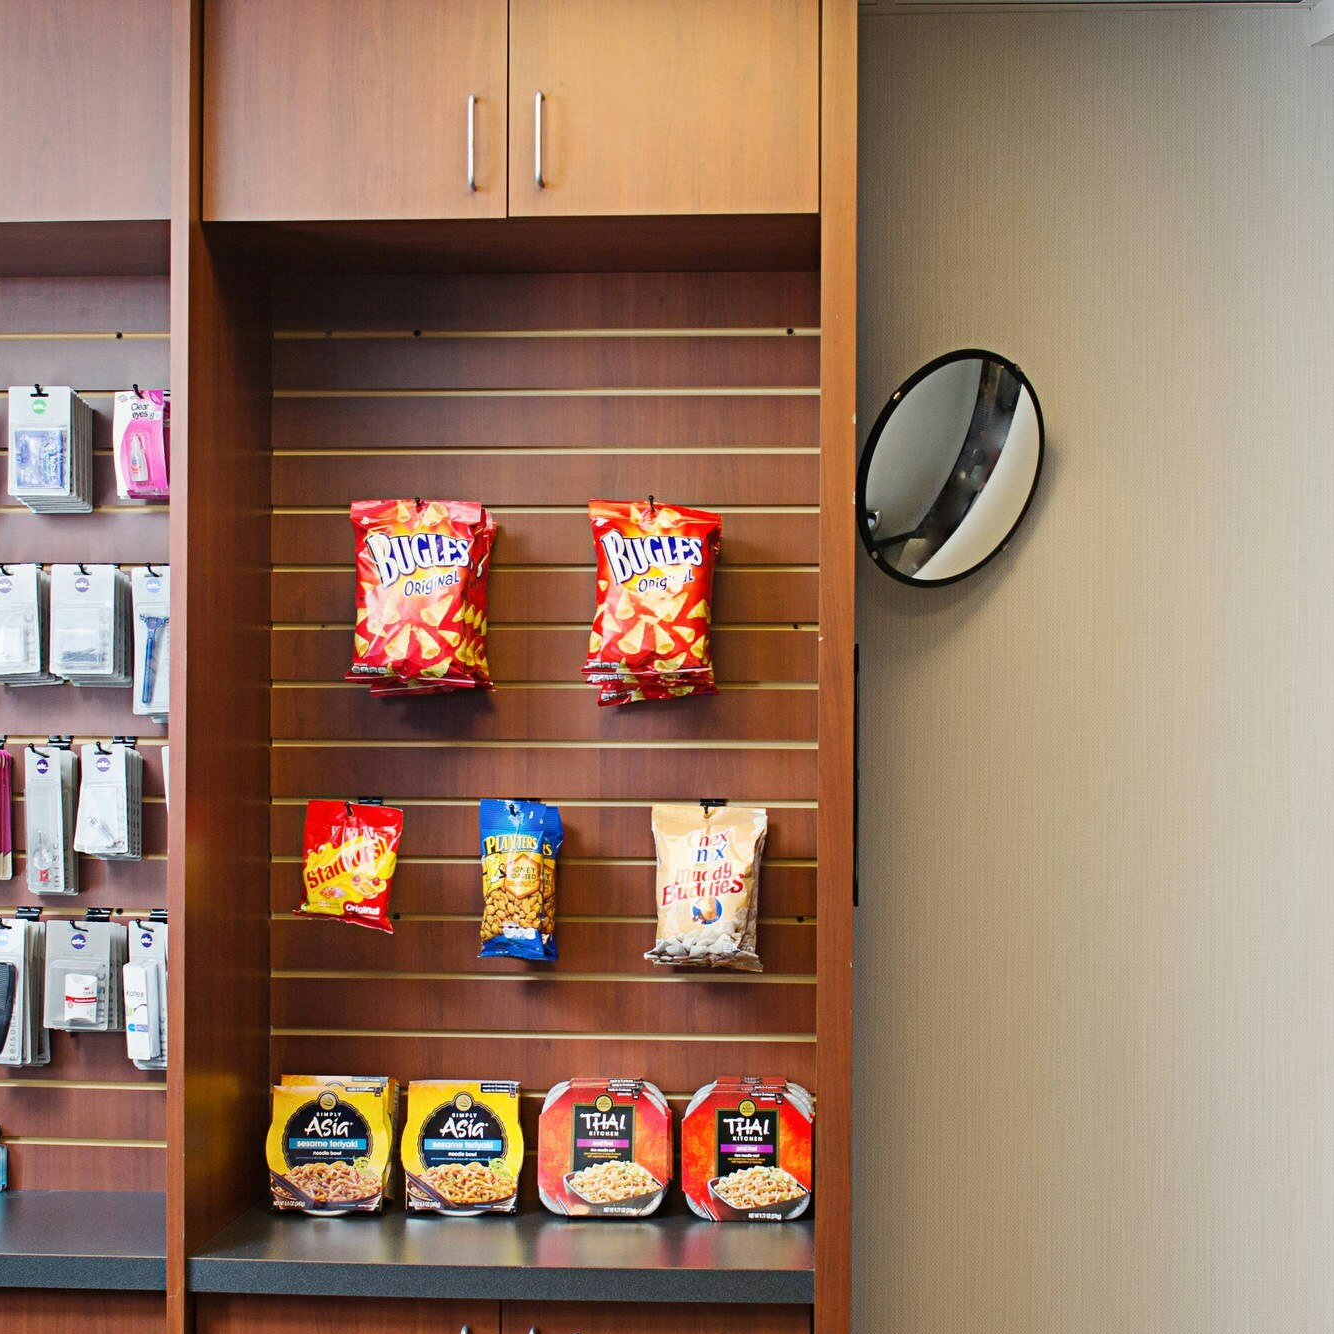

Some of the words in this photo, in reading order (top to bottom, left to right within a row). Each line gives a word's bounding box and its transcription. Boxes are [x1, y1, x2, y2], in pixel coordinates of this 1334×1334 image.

[365, 532, 470, 589] BUGLES
[600, 529, 704, 587] BUGLES
[346, 903, 381, 916] Original
[304, 1116, 349, 1138] Asia
[439, 1117, 485, 1139] Asia
[579, 1112, 626, 1131] THAI
[723, 1117, 770, 1136] THAI
[297, 1140, 329, 1148] sesame
[329, 1139, 358, 1150] teriyaki
[432, 1141, 464, 1149] sesame
[464, 1140, 494, 1151] teriyaki
